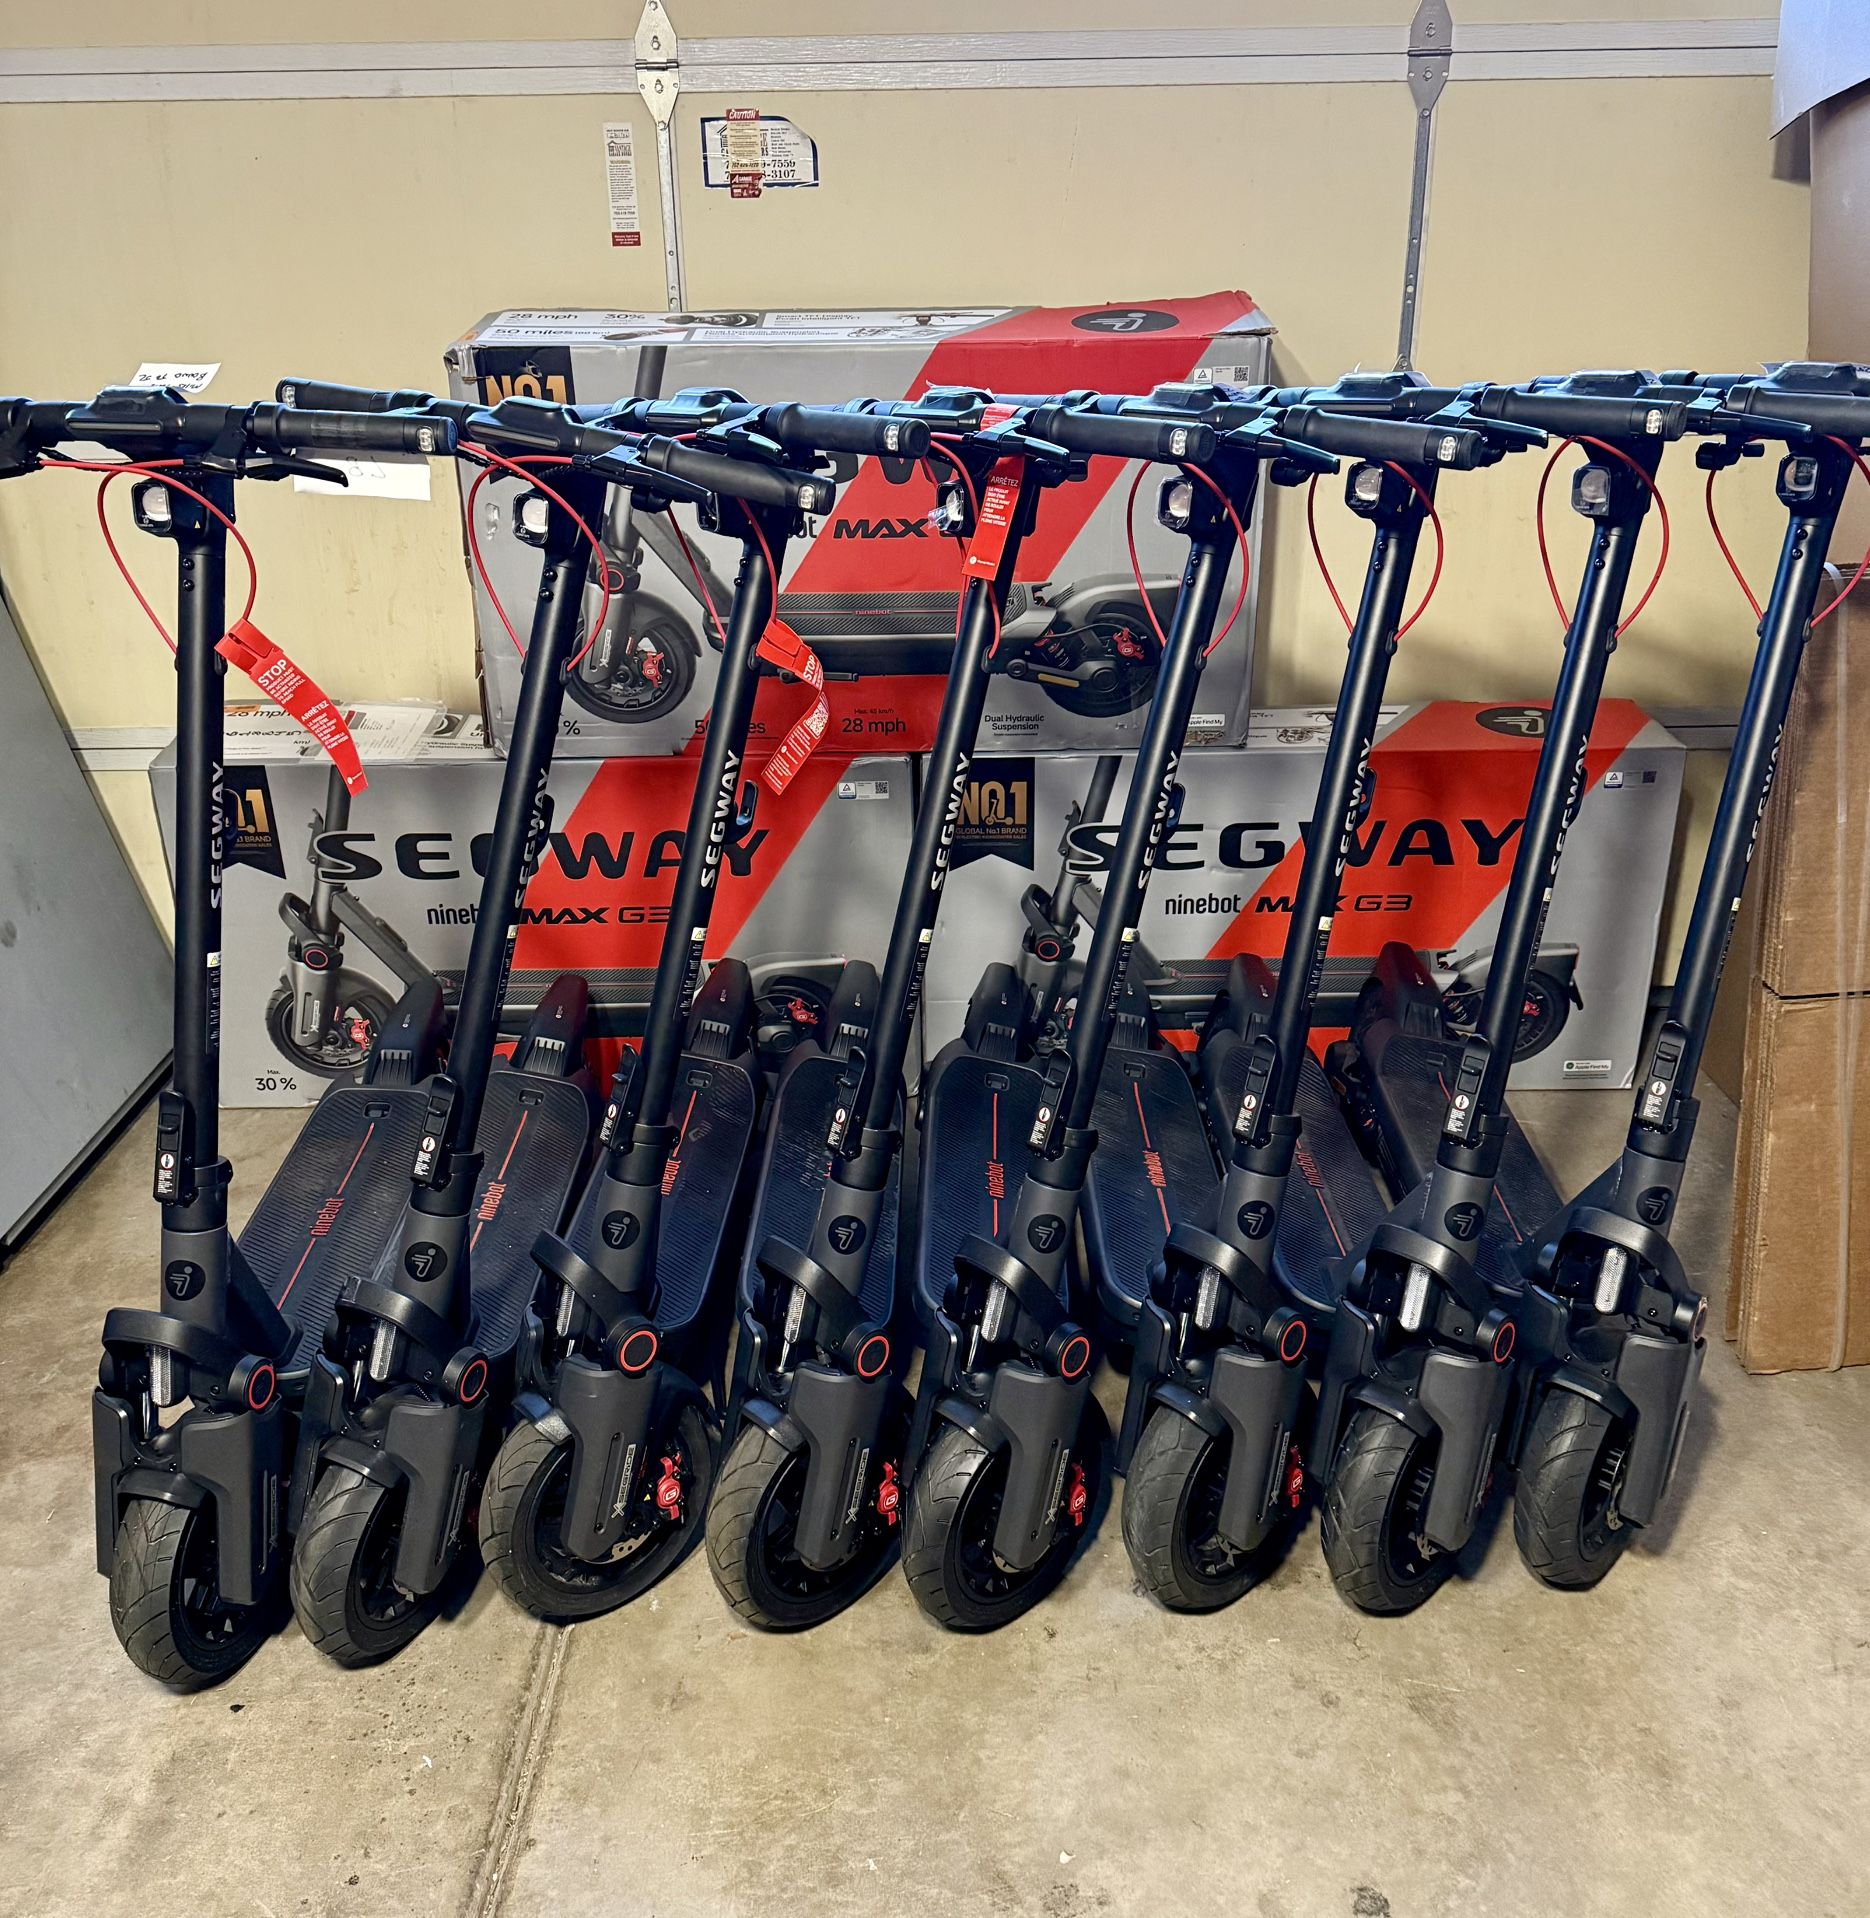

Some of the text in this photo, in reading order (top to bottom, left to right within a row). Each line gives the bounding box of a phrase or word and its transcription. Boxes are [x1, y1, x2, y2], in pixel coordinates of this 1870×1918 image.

[729, 110, 756, 119] CAUTION
[538, 313, 578, 321] mph
[604, 312, 646, 320] 30%
[991, 475, 1019, 487] ARRÊTEZ
[833, 518, 929, 539] MAX
[855, 608, 892, 617] ninebot
[257, 659, 287, 687] STOP
[803, 654, 816, 681] STOP
[301, 700, 329, 722] ARRÊTEZ
[984, 713, 1045, 724] Dual Hydraulic
[842, 717, 906, 737] 28 mph
[992, 722, 1039, 732] Suspension
[1550, 734, 1590, 877] SEGWAY
[1745, 723, 1785, 864] SEGWAY
[700, 747, 741, 889] SEGWAY
[931, 751, 972, 891] SEGWAY
[1137, 749, 1180, 890] SEGWAY
[1335, 737, 1373, 878] SEGWAY
[210, 761, 224, 909] SEGWAY
[245, 835, 272, 843] BRAND
[514, 767, 550, 909] SEGWAY
[428, 903, 672, 925] nineb MAX G3
[1165, 893, 1241, 915] ninebot
[1354, 894, 1413, 912] G3
[255, 1077, 297, 1091] 30 %
[985, 1160, 1004, 1199] ninebot
[1142, 1150, 1167, 1188] ninebot
[1295, 1151, 1326, 1190] ninebot
[475, 1181, 506, 1222] ninebot
[310, 1197, 345, 1237] ninebot
